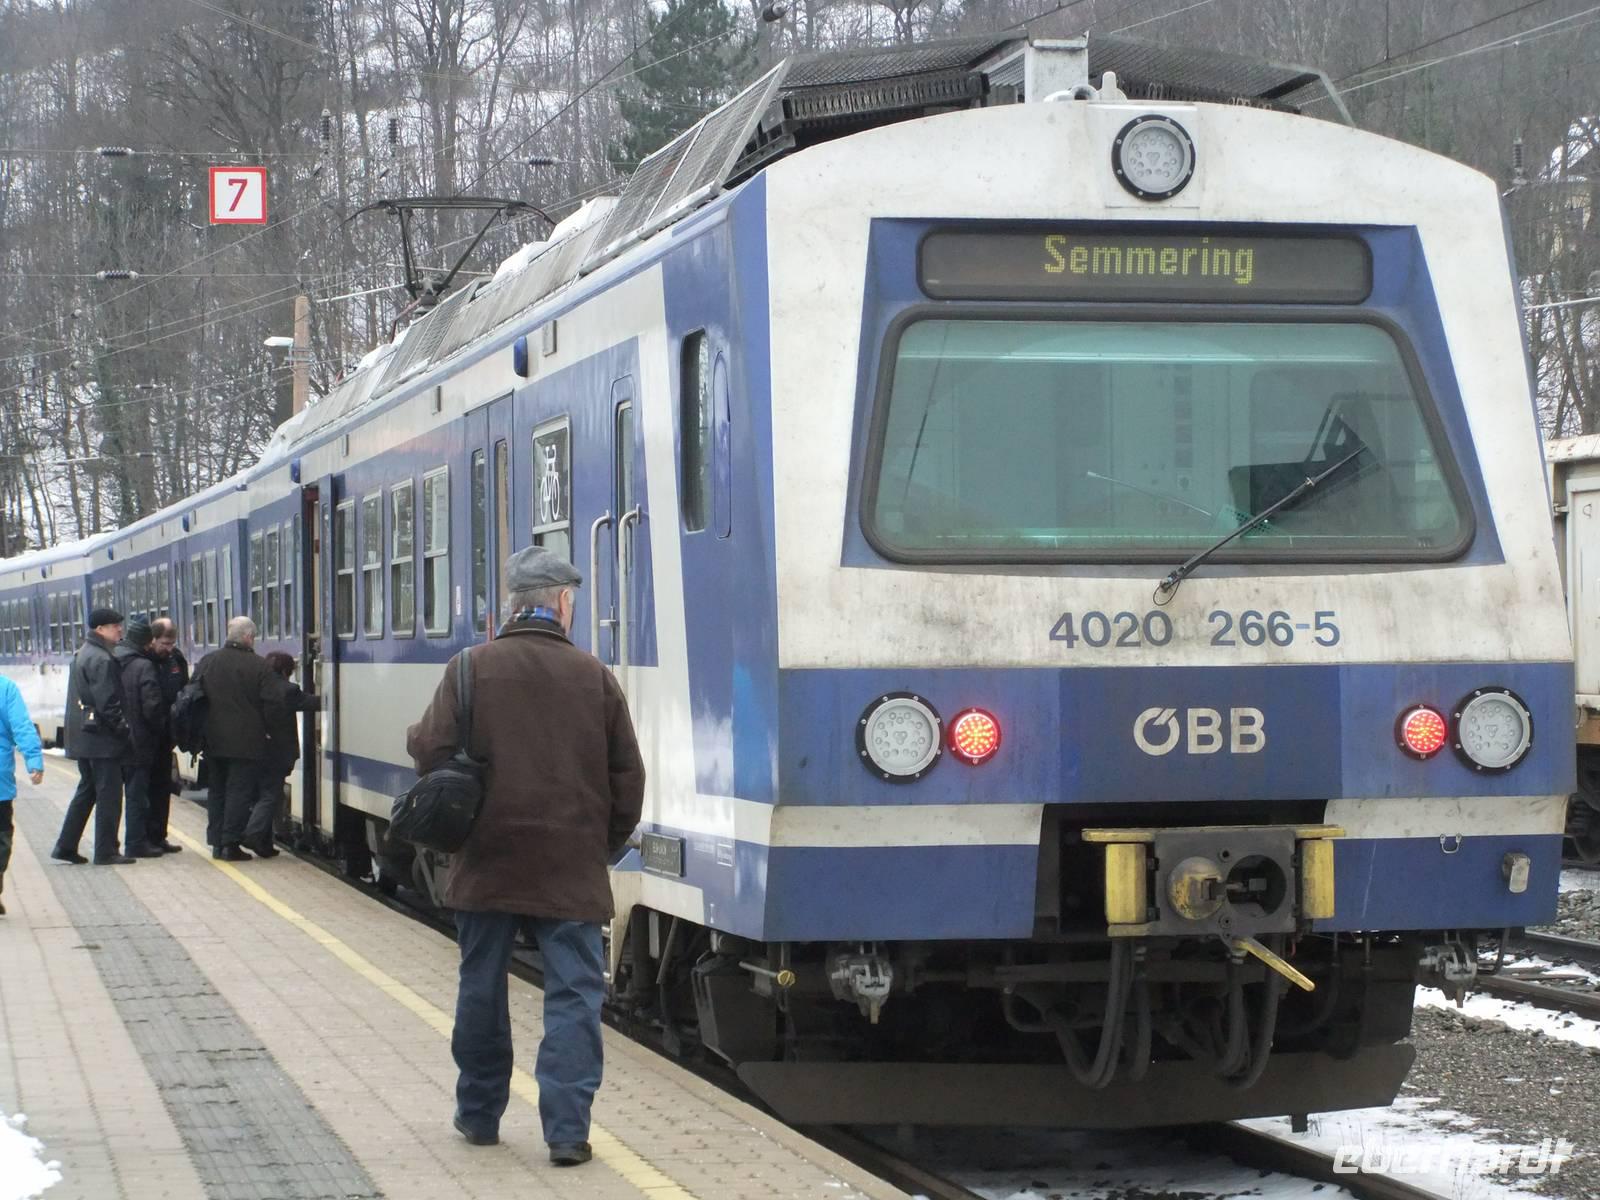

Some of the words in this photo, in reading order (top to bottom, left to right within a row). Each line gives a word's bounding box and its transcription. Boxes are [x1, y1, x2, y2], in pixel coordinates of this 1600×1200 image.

[228, 178, 248, 212] 7
[1044, 234, 1254, 285] Semmering
[1049, 610, 1174, 649] 4020
[1208, 610, 1341, 647] 266-5
[1133, 707, 1266, 757] ÖBB
